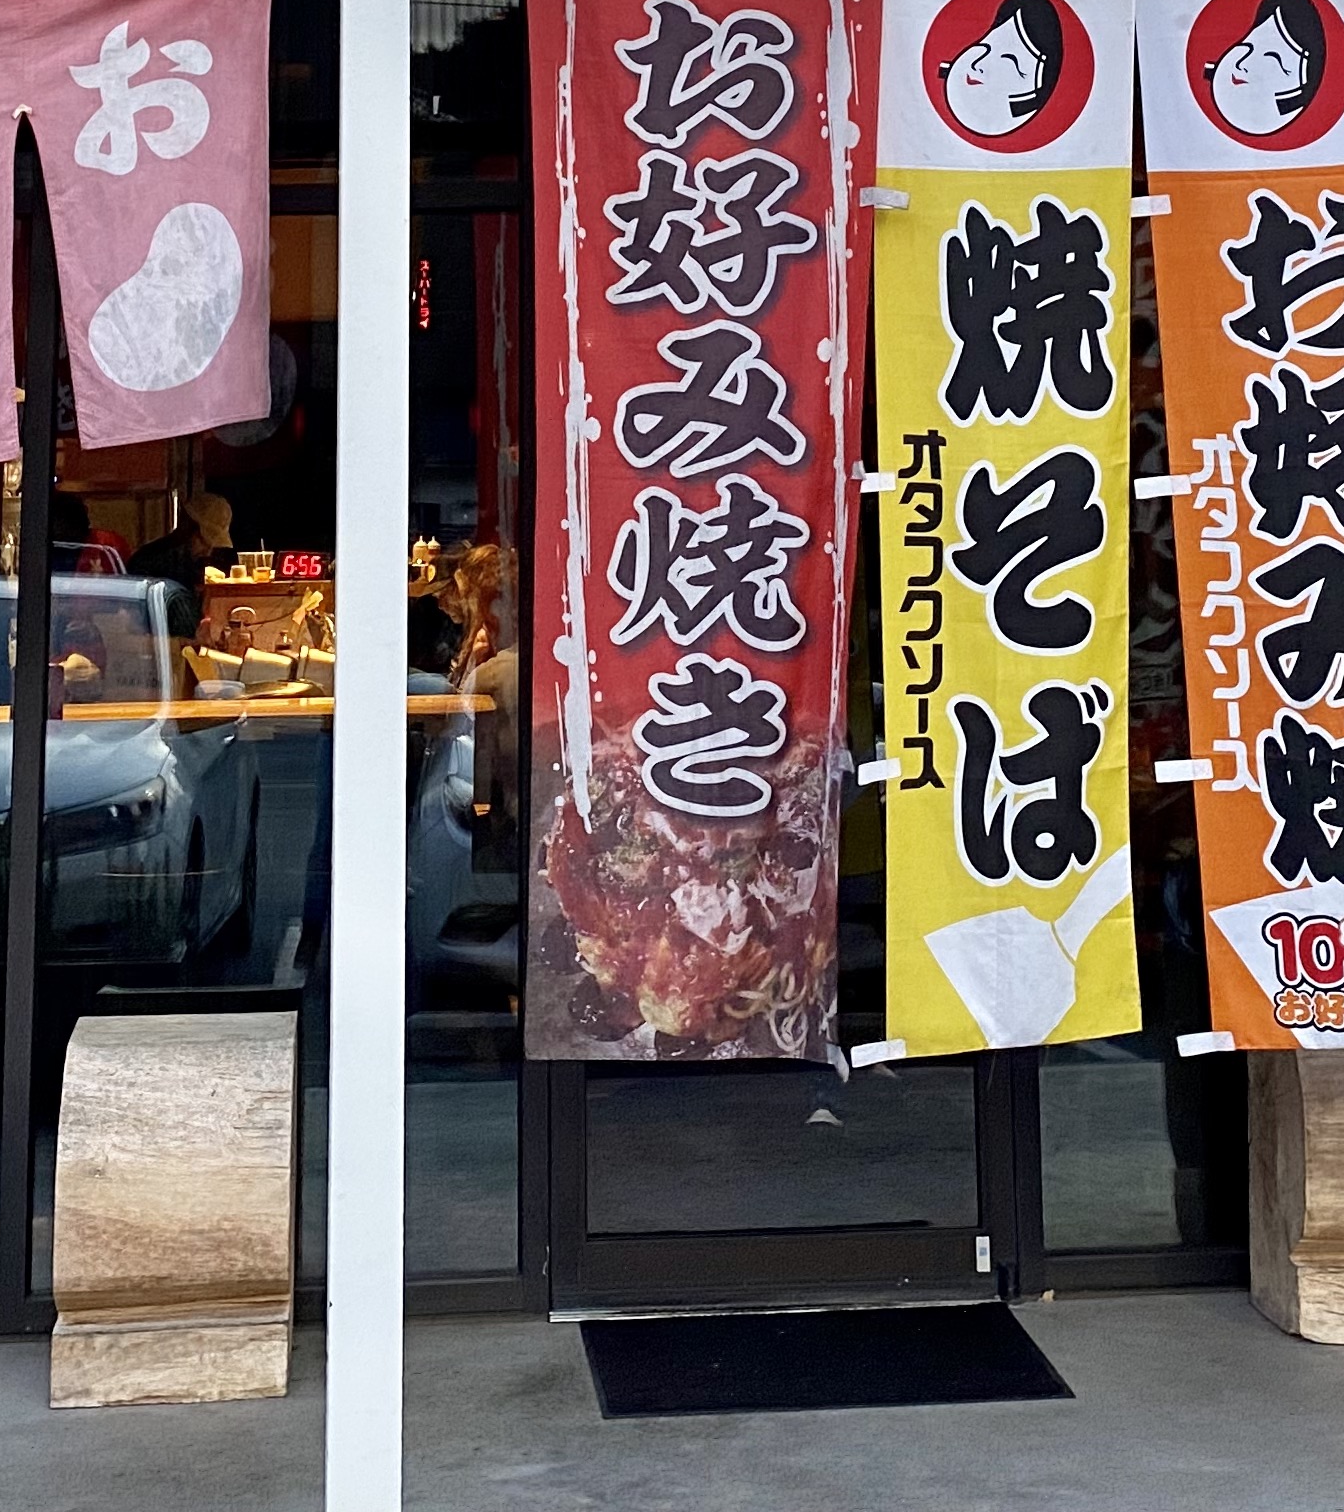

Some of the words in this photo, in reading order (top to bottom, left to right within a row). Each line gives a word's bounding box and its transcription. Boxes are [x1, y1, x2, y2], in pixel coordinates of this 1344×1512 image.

[282, 554, 322, 576] 6:56
[897, 429, 947, 790] オタフクソース
[939, 194, 1115, 885] 焼そば
[1191, 434, 1263, 793] オタフクソース
